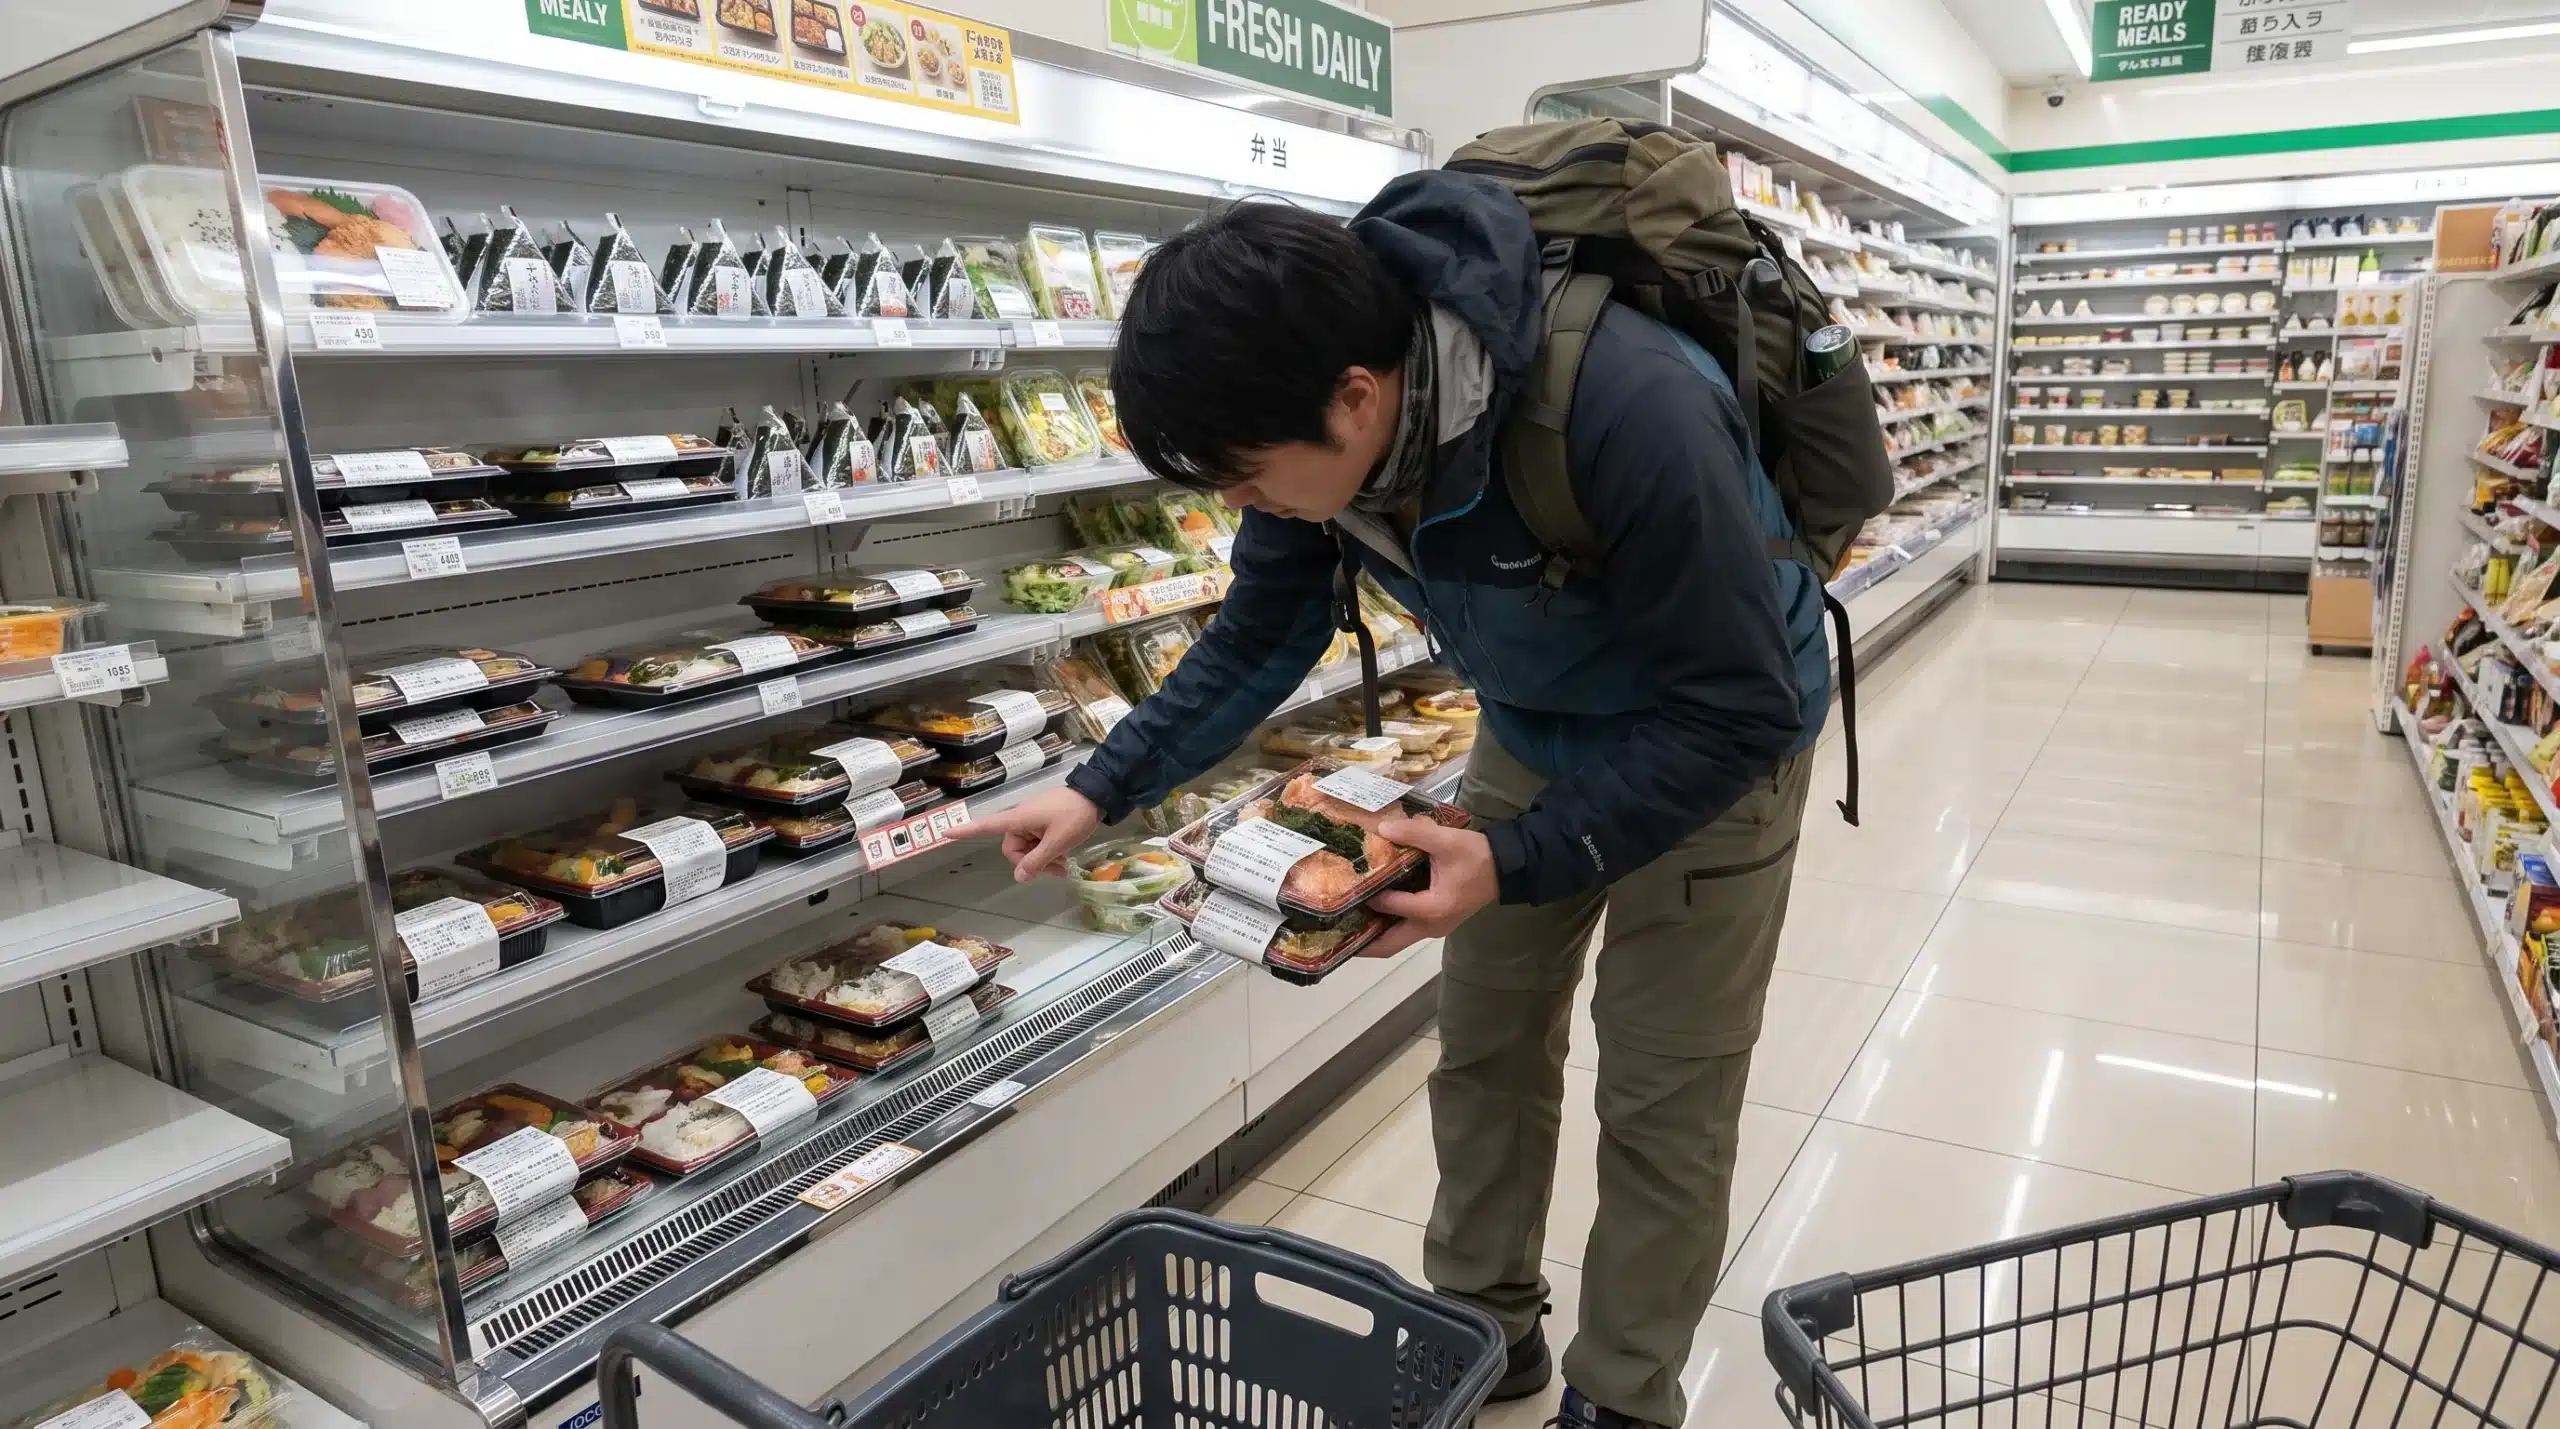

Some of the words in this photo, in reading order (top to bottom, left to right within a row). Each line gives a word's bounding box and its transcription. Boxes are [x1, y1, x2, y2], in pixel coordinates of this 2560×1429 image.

[539, 0, 609, 26] MEALY
[2119, 1, 2188, 26] READY
[1207, 0, 1303, 70] FRESH
[1311, 22, 1383, 92] DAILY
[2117, 22, 2188, 48] MEALS
[1250, 132, 1288, 169] 弁当
